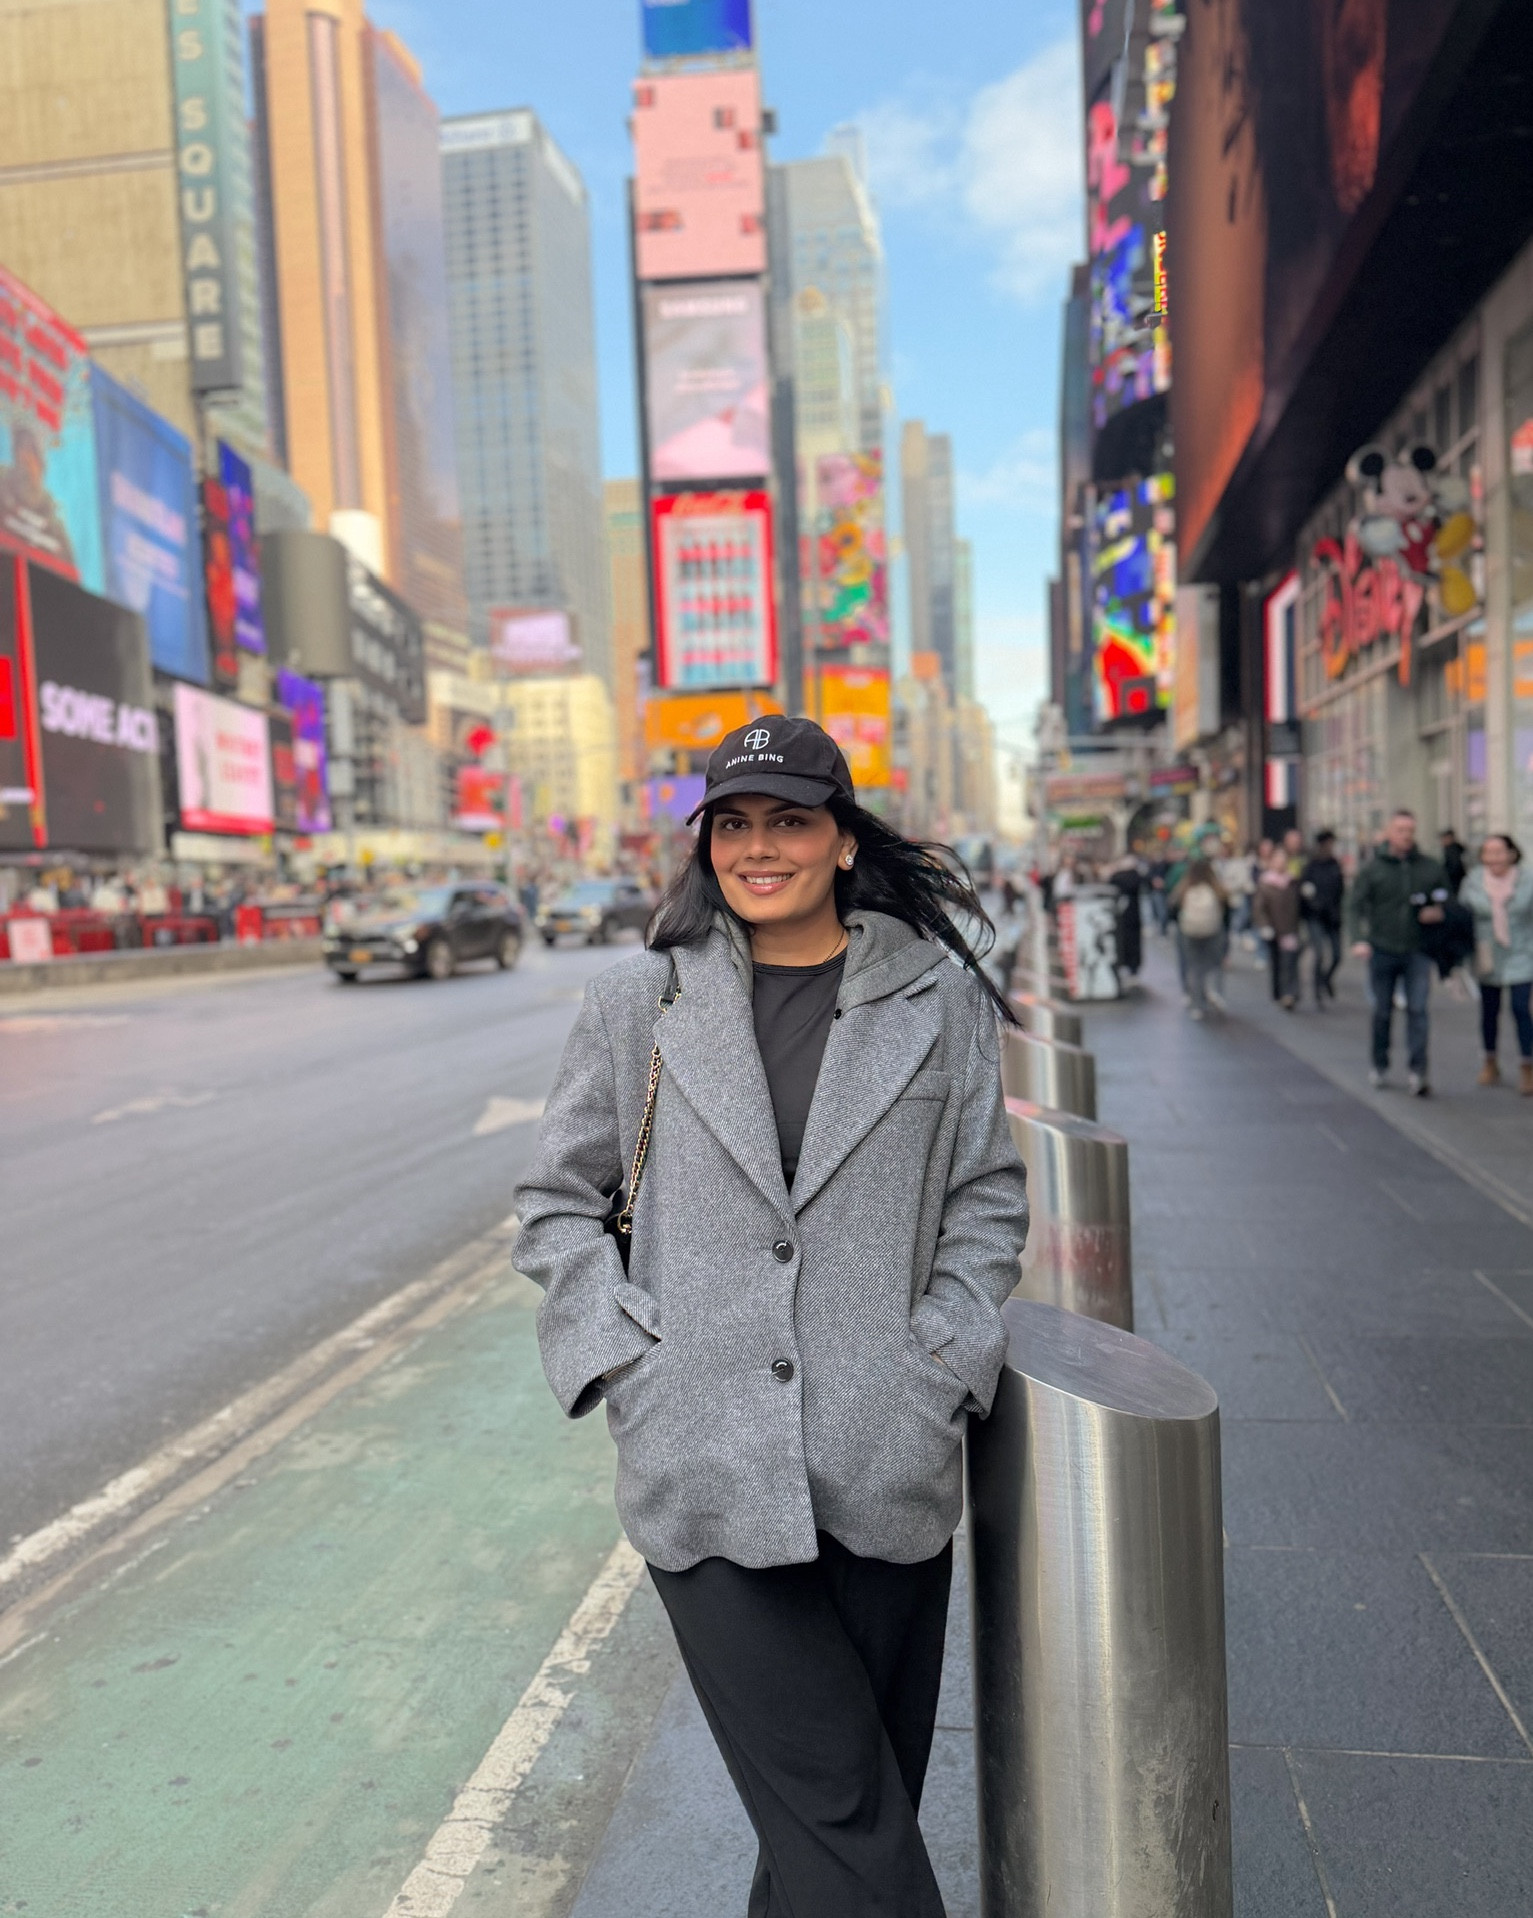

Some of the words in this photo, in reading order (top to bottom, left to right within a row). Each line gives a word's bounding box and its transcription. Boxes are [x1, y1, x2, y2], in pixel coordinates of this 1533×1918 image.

[179, 96, 224, 361] SQUARE
[744, 729, 770, 750] AB
[725, 754, 754, 769] ANINE
[757, 753, 784, 763] BING
